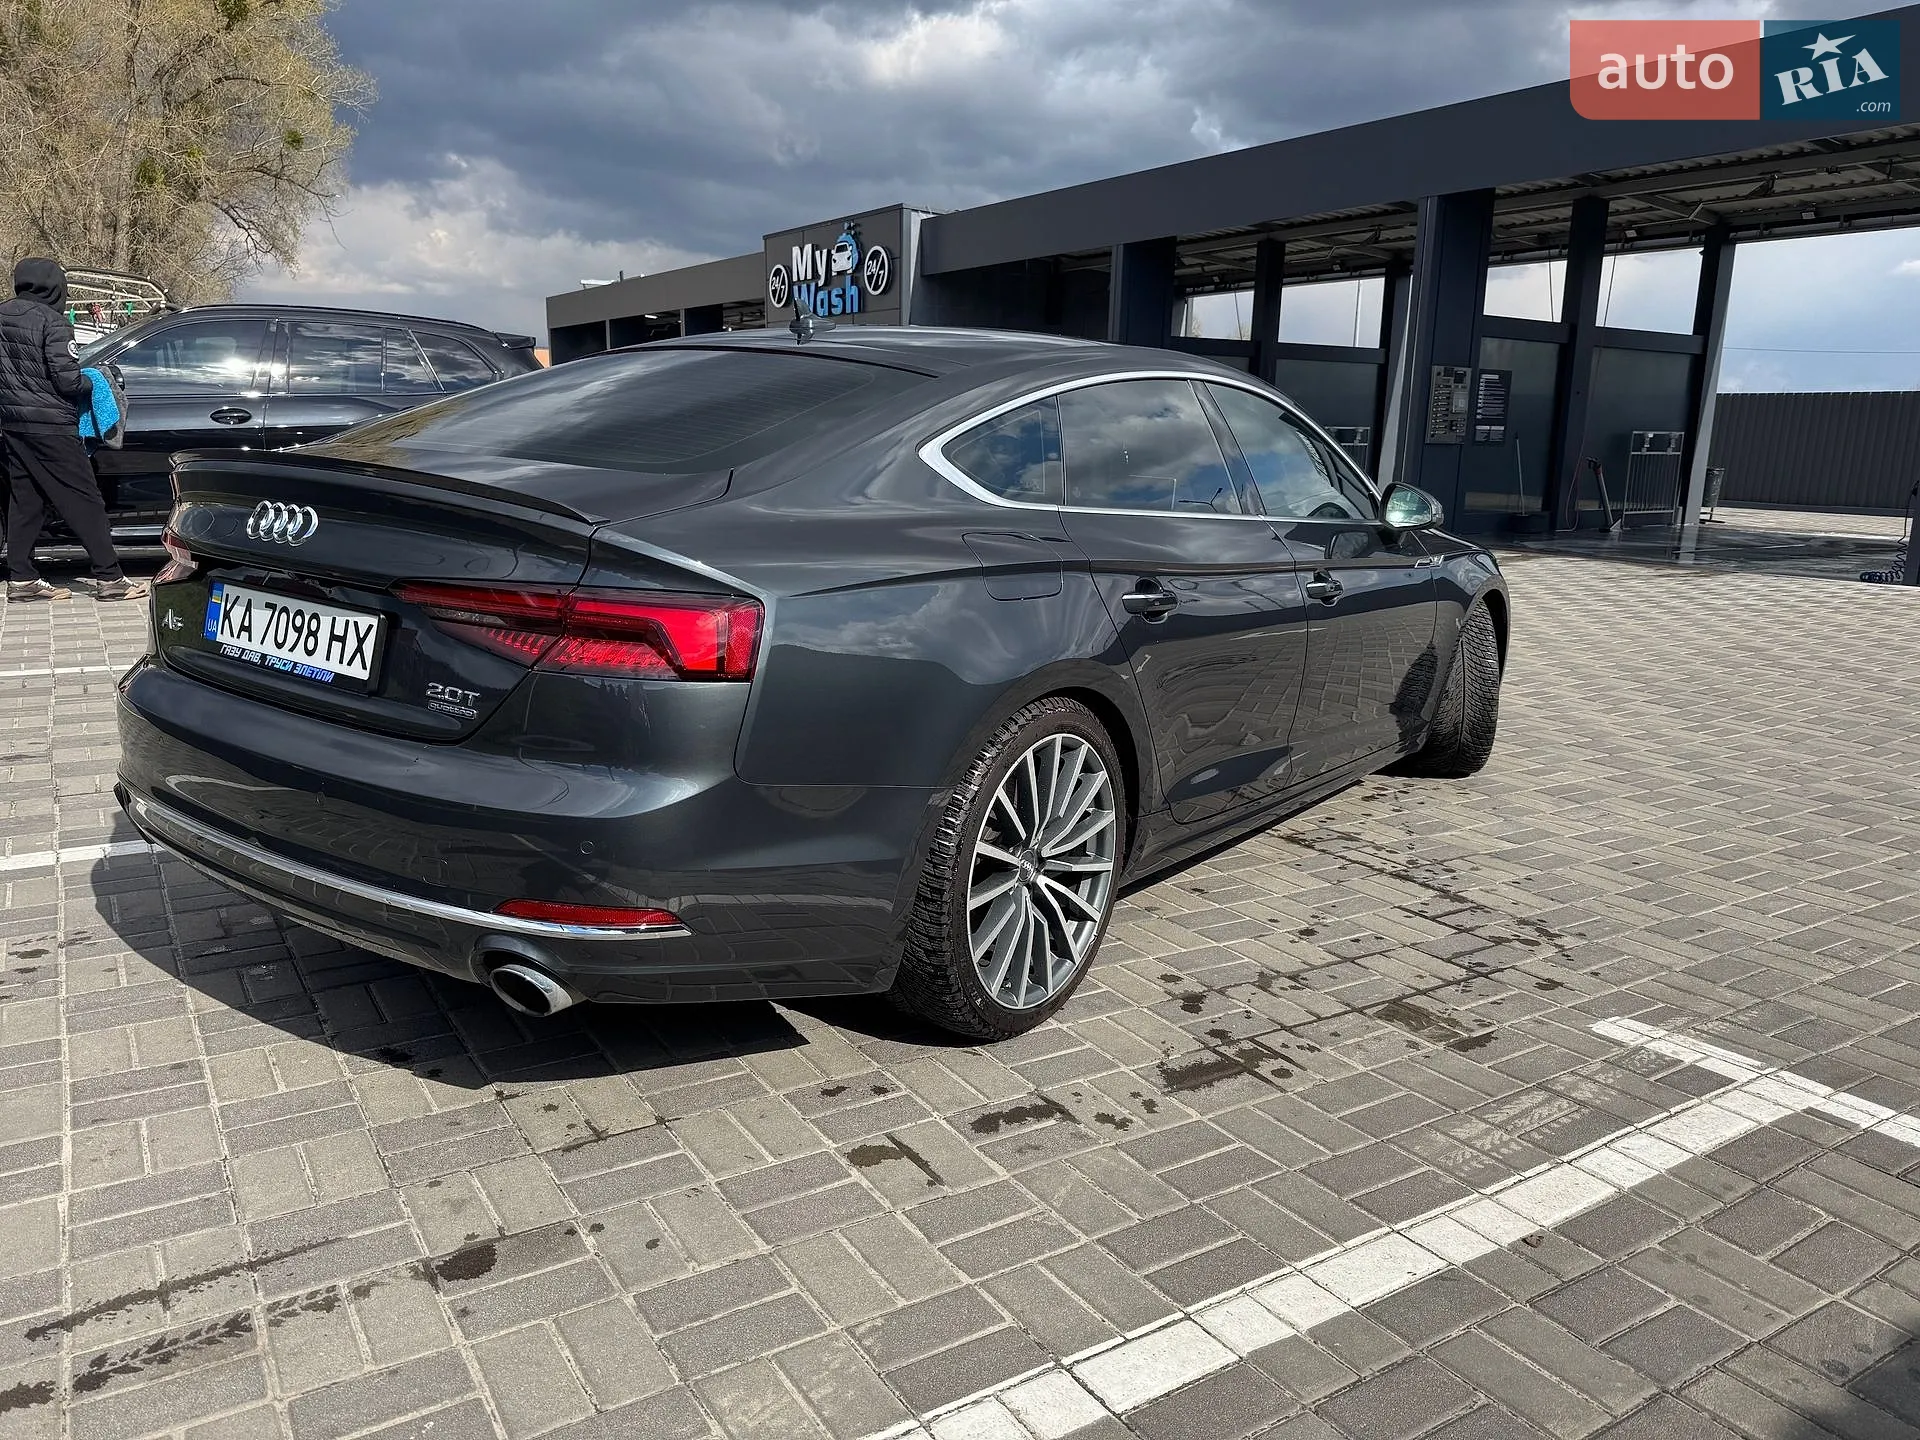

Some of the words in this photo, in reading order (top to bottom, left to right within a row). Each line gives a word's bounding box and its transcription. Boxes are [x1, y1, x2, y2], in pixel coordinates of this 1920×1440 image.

[792, 243, 828, 287] My
[866, 253, 885, 291] 24/7
[771, 271, 786, 307] 24/7
[793, 276, 860, 316] Wash
[207, 622, 217, 632] UA
[220, 593, 253, 642] KA
[260, 601, 322, 657] 7098
[325, 616, 374, 671] HX
[264, 655, 294, 672] ТРУСИ
